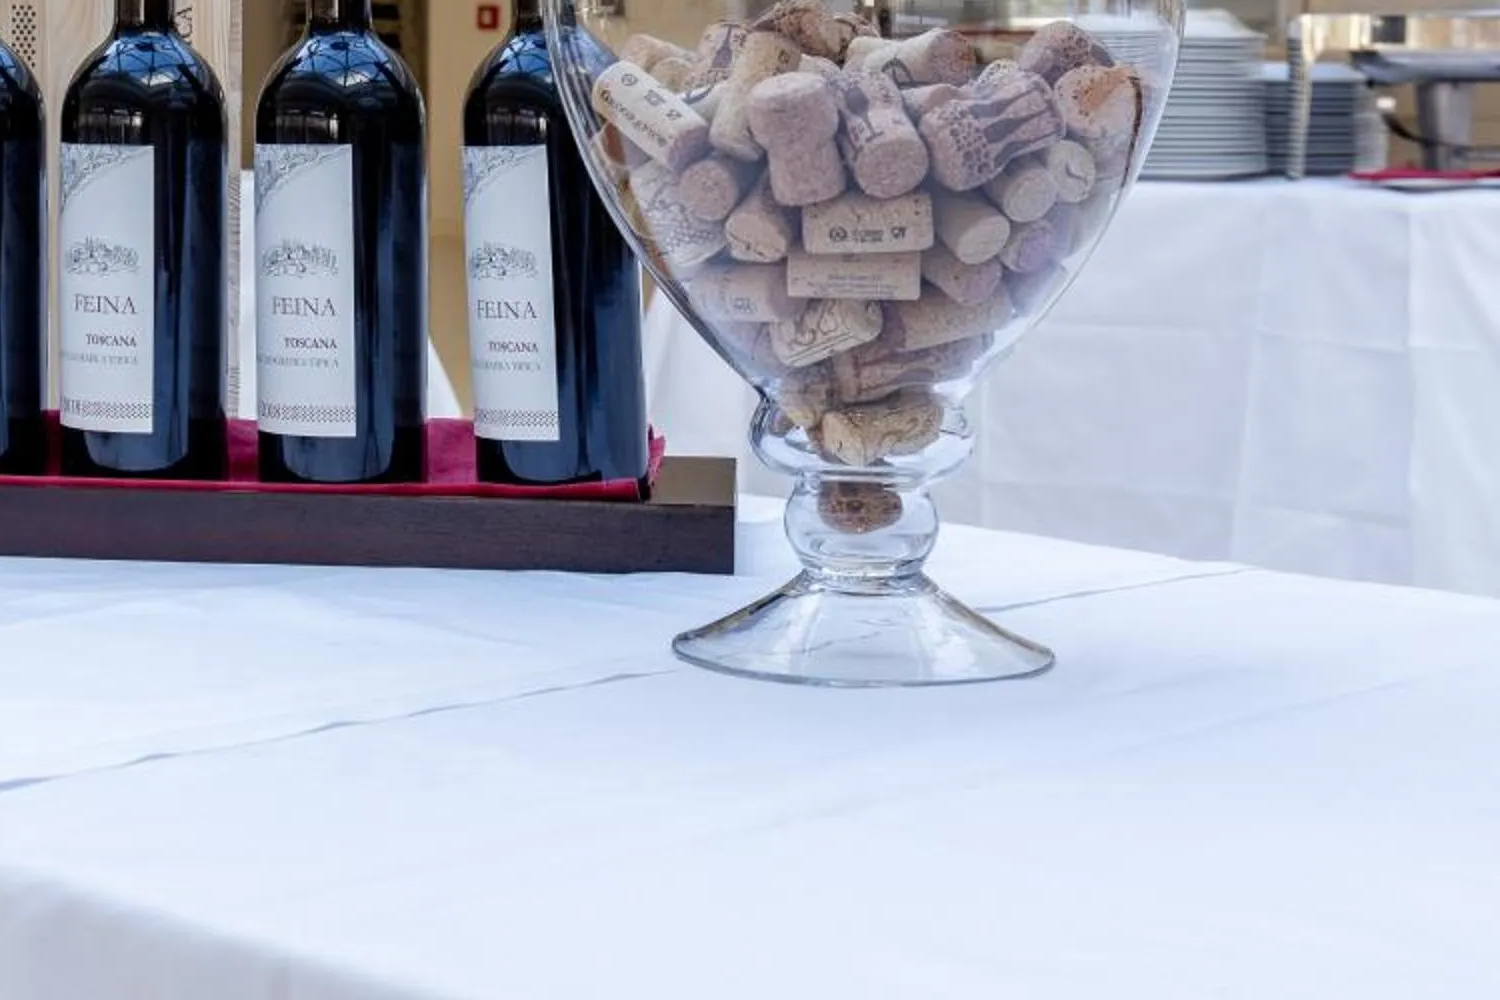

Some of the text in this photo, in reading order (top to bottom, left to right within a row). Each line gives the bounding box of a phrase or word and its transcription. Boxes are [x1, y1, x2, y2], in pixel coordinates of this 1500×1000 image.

[74, 293, 138, 316] FEINA
[271, 295, 337, 317] FEINA
[476, 299, 539, 319] FEINA
[86, 333, 138, 348] TOSCANA
[284, 337, 339, 349] TOSCANA
[488, 340, 540, 353] TOSCANA
